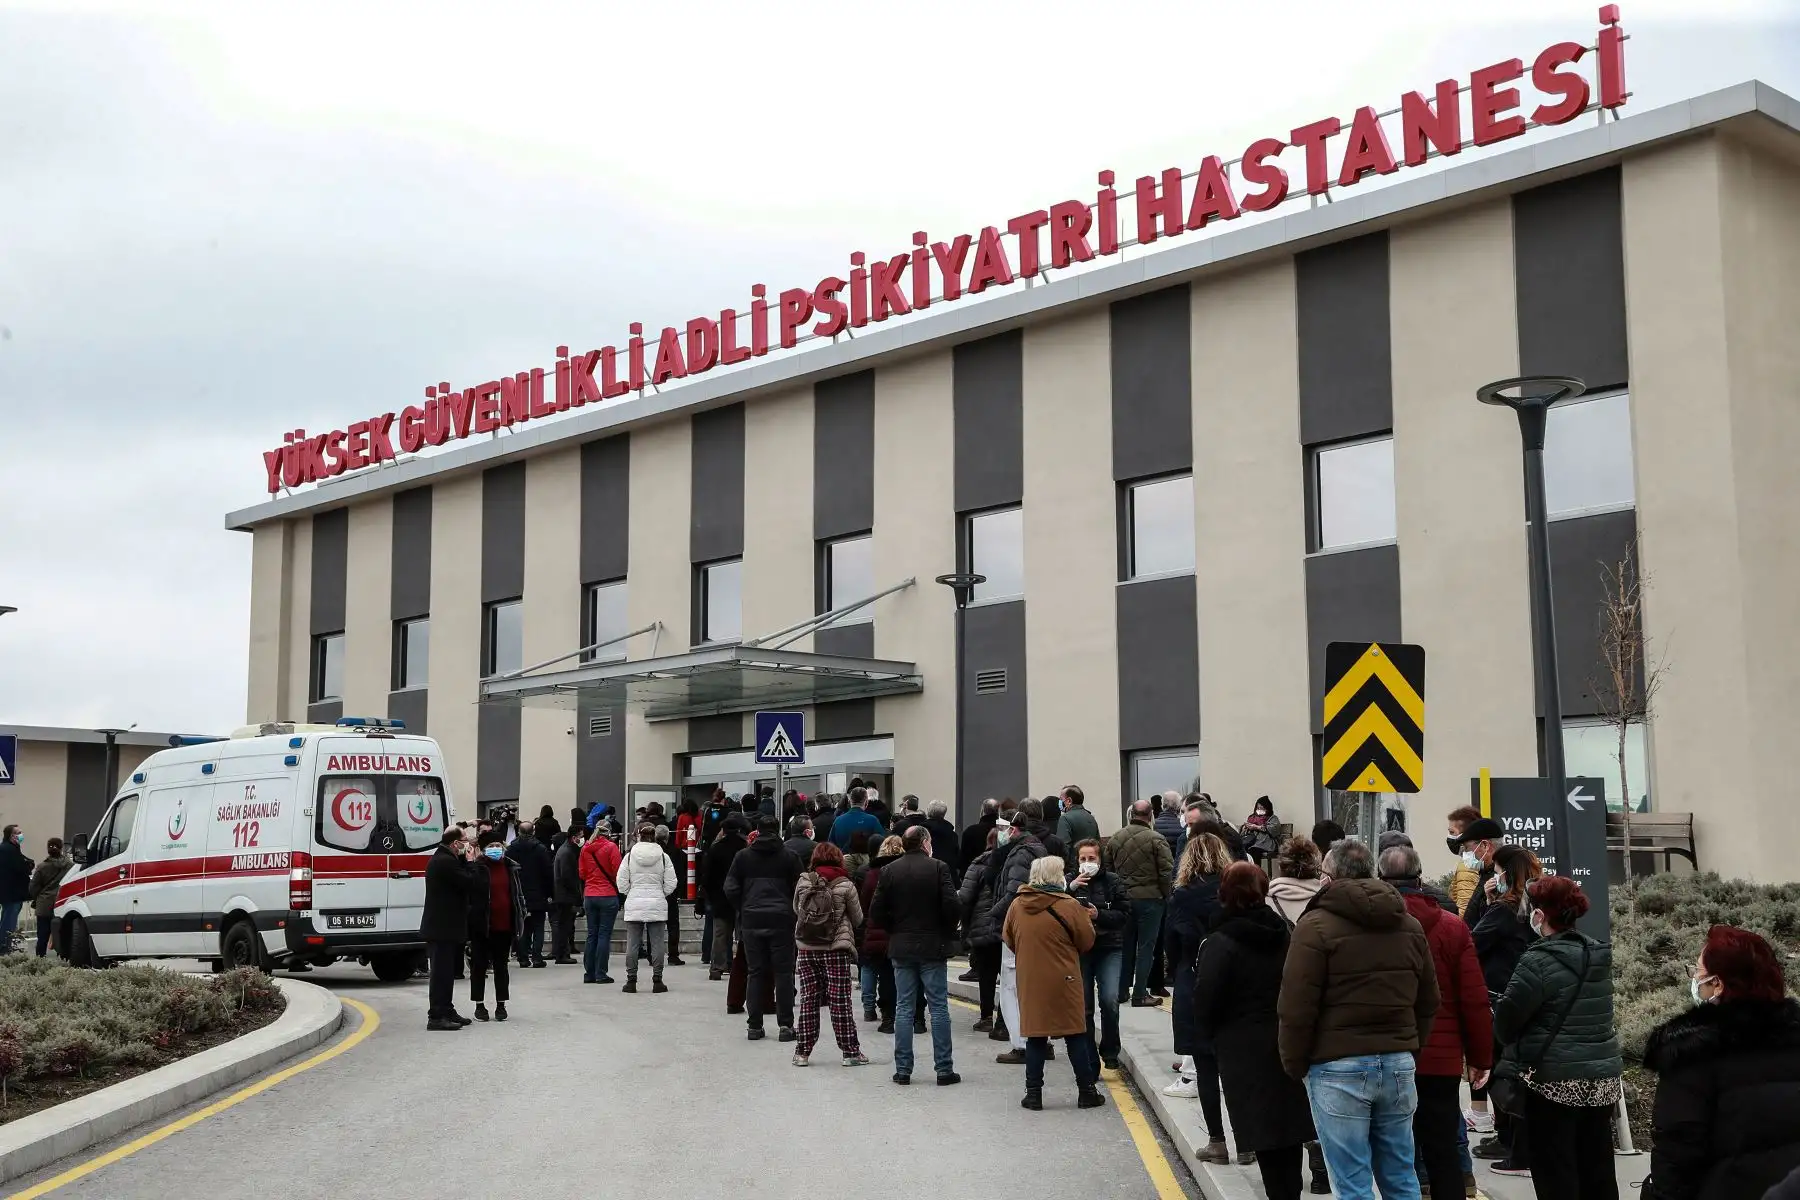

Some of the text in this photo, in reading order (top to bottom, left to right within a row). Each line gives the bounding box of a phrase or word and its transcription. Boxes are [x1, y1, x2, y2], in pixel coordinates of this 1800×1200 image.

[263, 3, 1627, 493] YÜKSEK GÜVENLİKLİ ADLİ PSİKİYATRİ HASTANESİ
[326, 755, 432, 773] AMBULANS
[244, 785, 257, 800] T.C.
[217, 799, 281, 821] SAĞLIK BAKANLIĞI
[348, 801, 372, 821] 112
[232, 820, 260, 848] 112
[1502, 833, 1545, 851] Girişi
[231, 852, 289, 870] AMBULANS
[345, 916, 355, 925] FM
[357, 915, 374, 925] 6475
